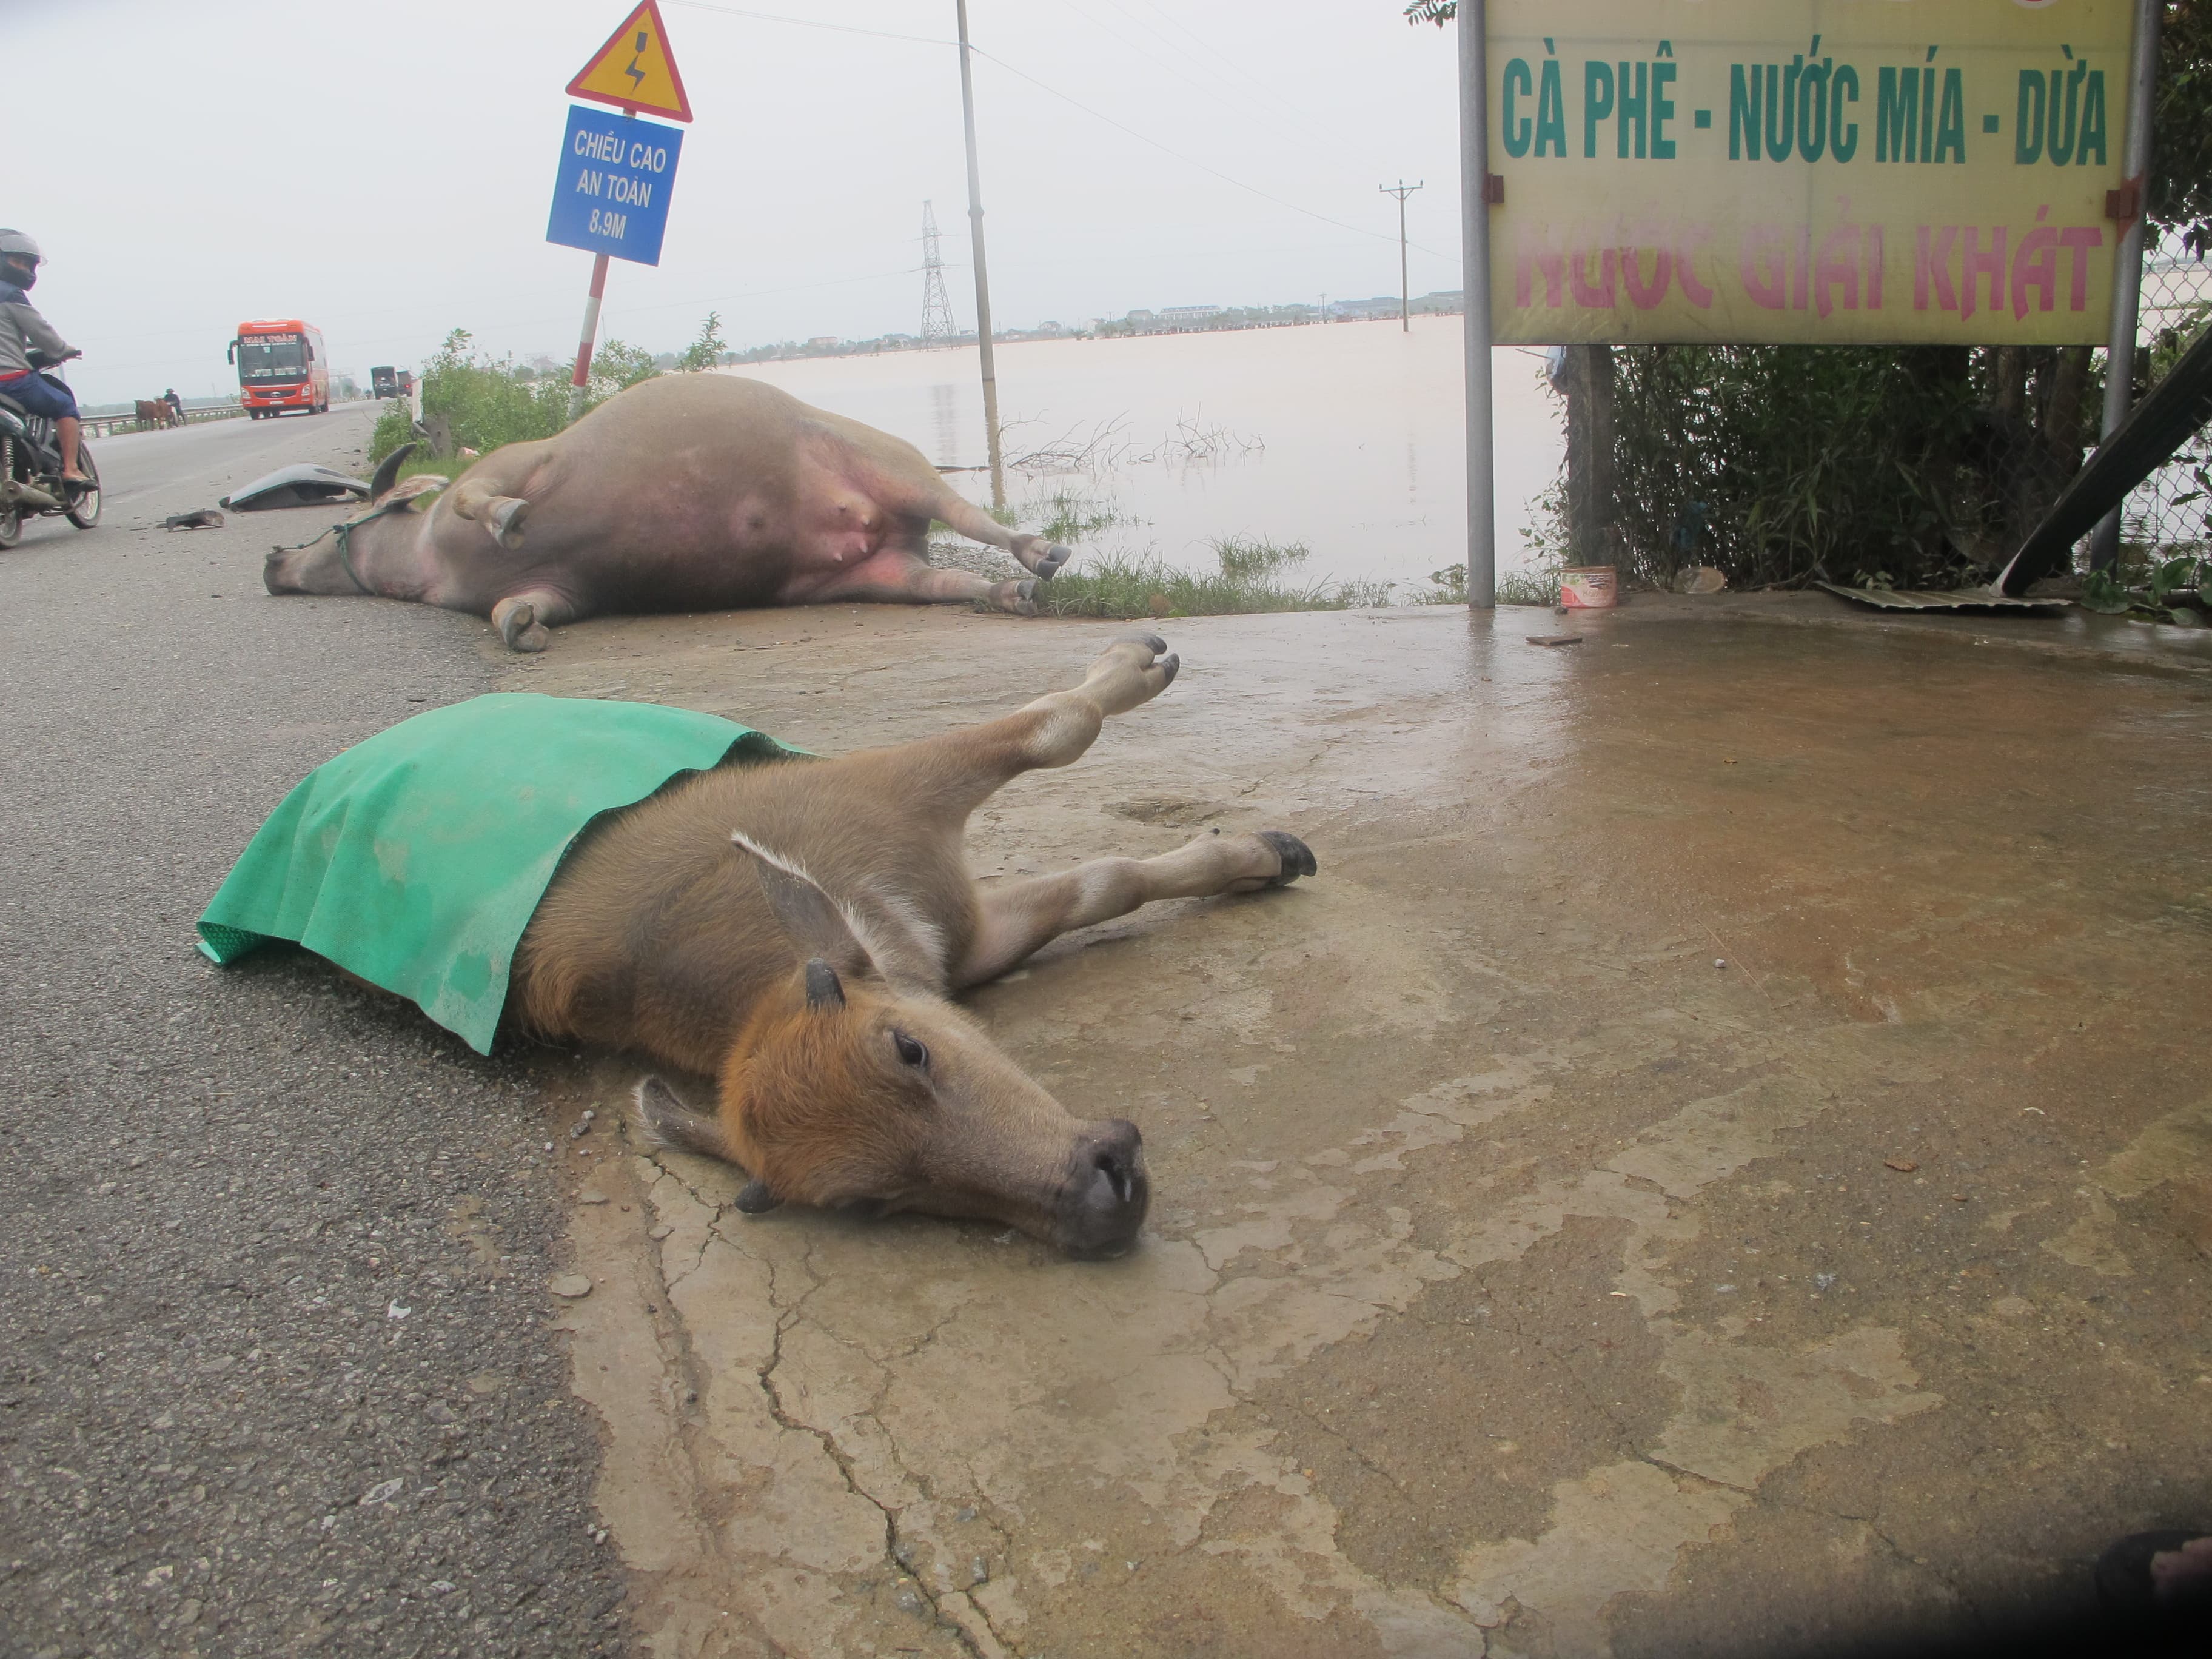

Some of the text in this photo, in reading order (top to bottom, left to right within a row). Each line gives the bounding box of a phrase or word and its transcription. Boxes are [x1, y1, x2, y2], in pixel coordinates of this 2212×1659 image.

[1502, 38, 1567, 159] CÀ
[1584, 40, 1677, 159] PHÊ
[1729, 35, 1859, 163] NƯỚC
[1876, 45, 1965, 164] MÍA
[2015, 44, 2106, 166] DỪA
[575, 130, 666, 173] CHIỀU CAO
[576, 169, 652, 208] AN TOÀN
[1740, 195, 1883, 320] GIẢI
[1914, 204, 2102, 322] KHÁT
